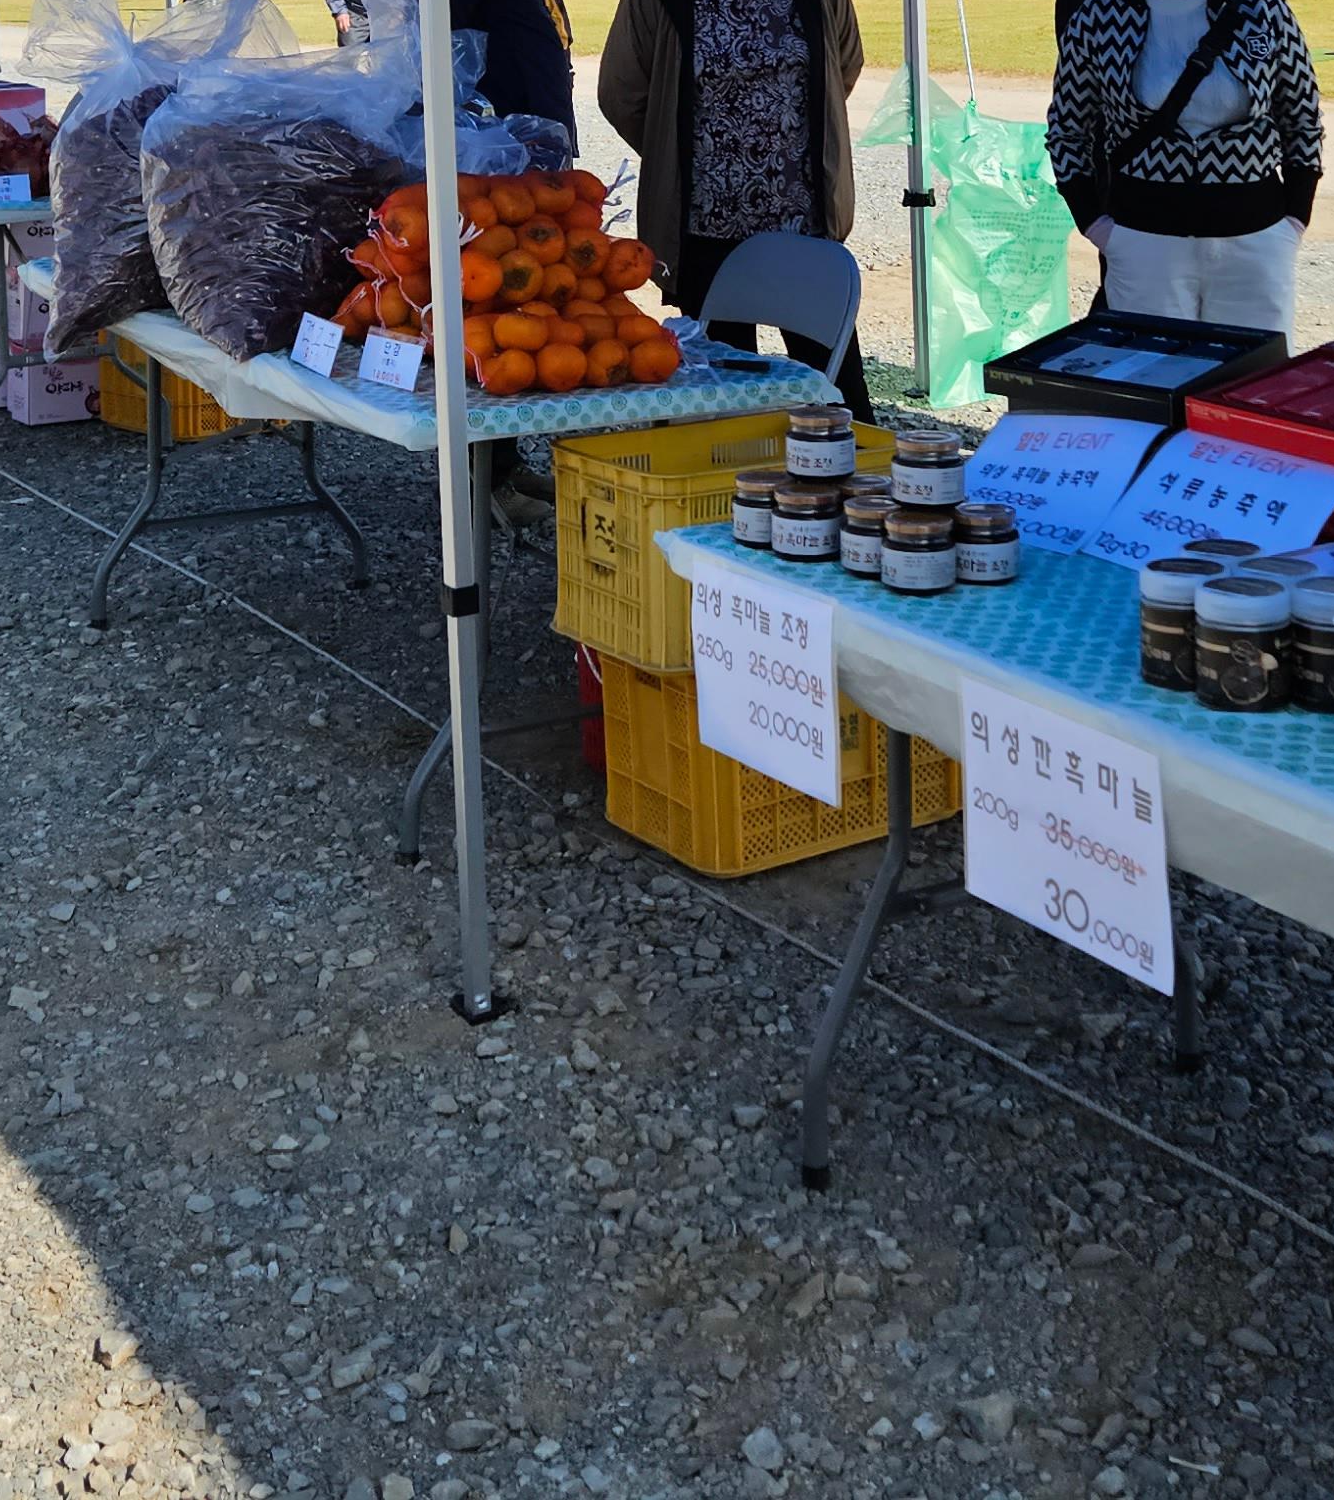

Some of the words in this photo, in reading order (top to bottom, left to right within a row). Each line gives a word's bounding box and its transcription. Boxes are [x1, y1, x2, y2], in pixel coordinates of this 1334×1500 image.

[1015, 432, 1052, 452] 할인
[1052, 432, 1115, 451] EVENT
[1189, 441, 1230, 463] 할인
[1232, 450, 1305, 478] EVENT
[979, 463, 1009, 480] 의성
[1011, 466, 1051, 485] 흑마늘
[1056, 469, 1100, 488] 농축액
[696, 583, 722, 617] 의성
[731, 595, 771, 636] 흑마늘
[781, 611, 809, 650] 조청
[697, 634, 734, 671] 250g
[748, 650, 825, 708] 25,000원
[748, 700, 824, 759] 20,000원
[973, 787, 1019, 831] 200g
[1044, 811, 1139, 887] 35,000원
[1044, 878, 1155, 974] 30,000원
